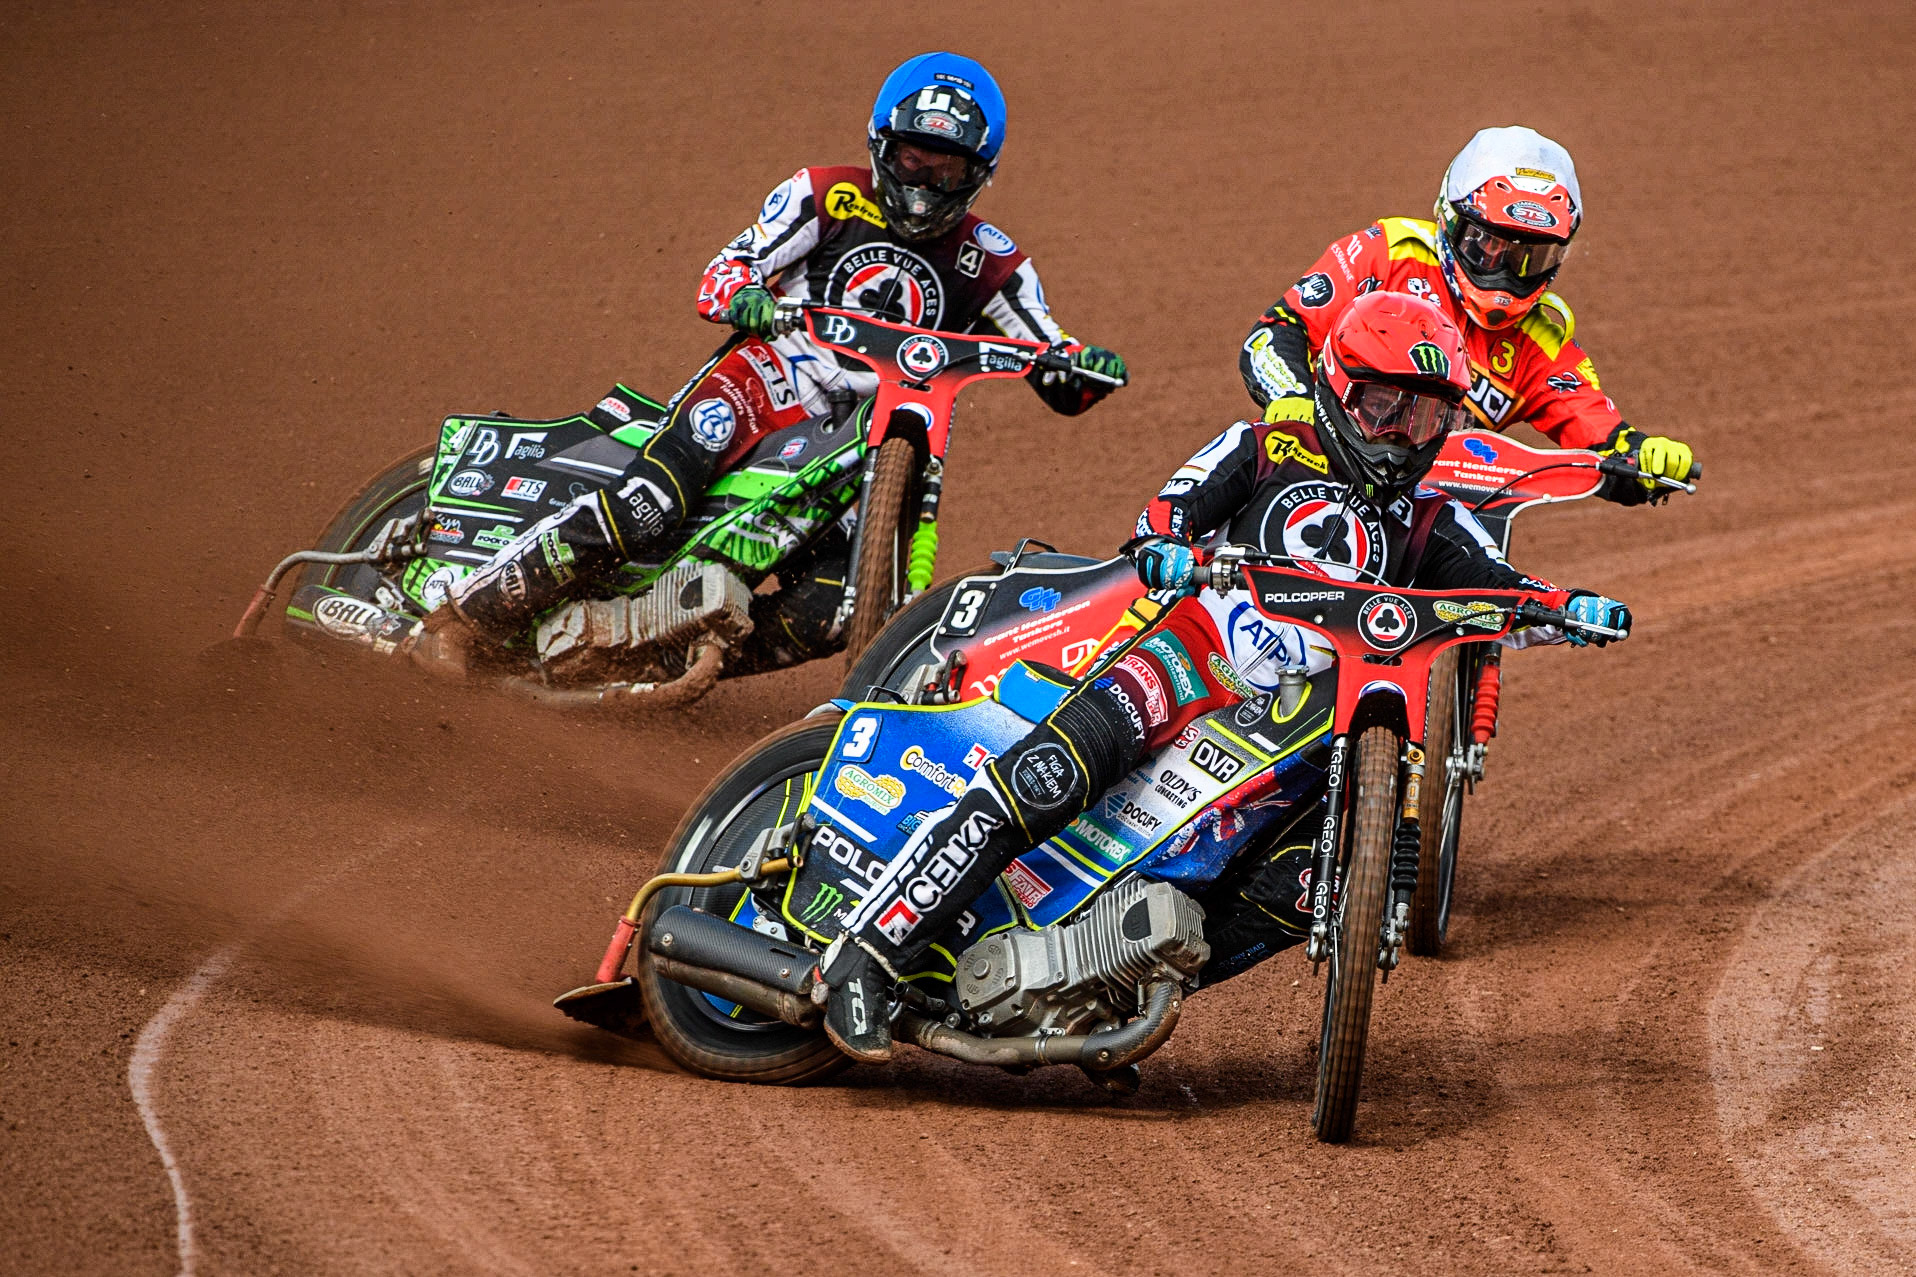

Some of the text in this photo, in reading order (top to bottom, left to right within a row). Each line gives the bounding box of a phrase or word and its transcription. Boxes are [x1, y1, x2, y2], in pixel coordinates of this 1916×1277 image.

[960, 249, 978, 272] 4
[843, 250, 937, 316] BELLE VUE ACES
[989, 353, 1023, 371] agilia
[1491, 341, 1515, 374] 3
[449, 426, 471, 449] 4
[514, 444, 546, 460] agilia
[1432, 460, 1525, 477] rant Henderso
[1454, 470, 1505, 483] Tankers
[629, 491, 664, 537] agilia
[1281, 488, 1380, 563] BELLE VUE ACES
[478, 535, 500, 544] ROCK
[951, 590, 986, 629] 3
[1264, 591, 1345, 603] POLCOPPER
[1363, 597, 1414, 619] BELLE VUE ACES
[1440, 603, 1497, 622] AGROIX
[984, 600, 1091, 646] Grant Henderson
[1013, 620, 1063, 643] Tankers
[1241, 620, 1292, 667] ATP
[1150, 637, 1193, 698] MOTOREX
[1109, 684, 1145, 739] DOCUFY
[842, 718, 878, 757] 3
[1027, 754, 1040, 763] Z
[1046, 754, 1065, 778] FIGA
[1193, 741, 1239, 782] DVR
[1329, 752, 1343, 787] GEO
[845, 769, 895, 804] AGROMIX
[1033, 761, 1062, 798] NAKIEM
[1160, 770, 1202, 802] OLDY'S
[1154, 784, 1188, 809] CONCRETING
[1122, 801, 1162, 831] DOCUFY
[1076, 819, 1130, 863] MOTOREX
[1321, 816, 1335, 853] GEO
[1313, 883, 1328, 918] GEO
